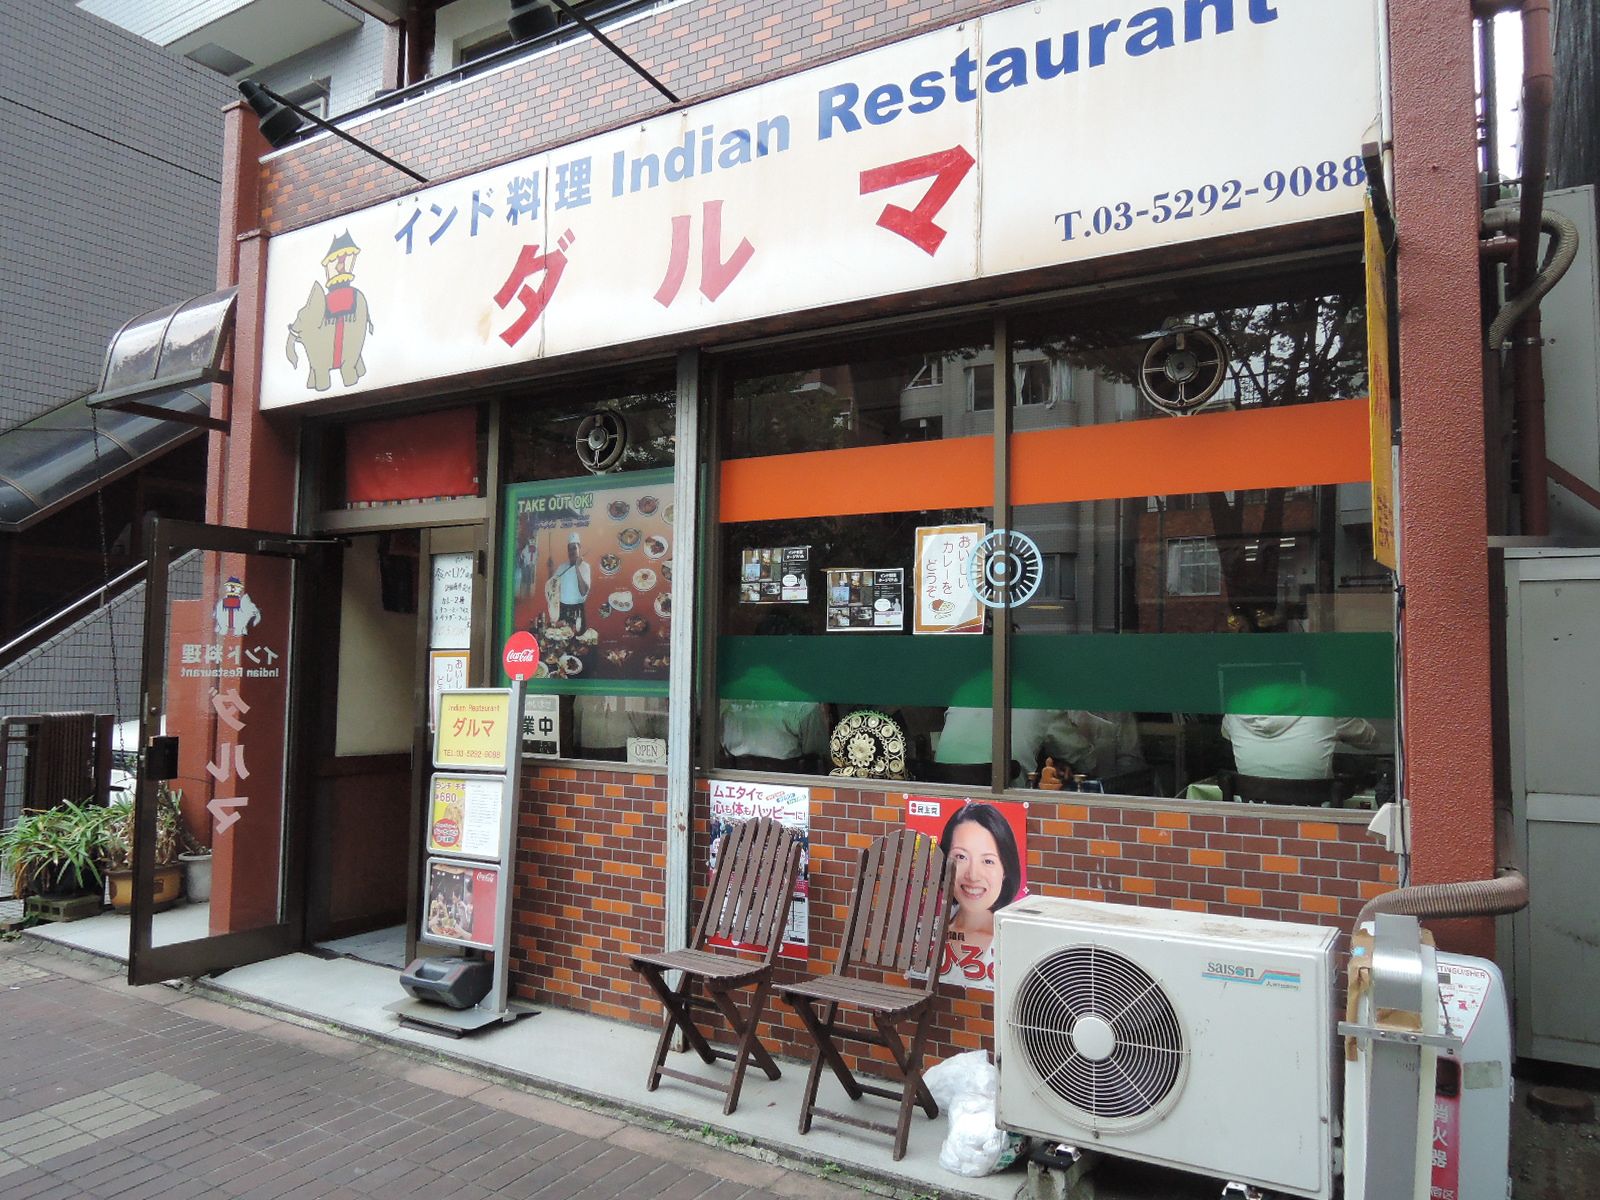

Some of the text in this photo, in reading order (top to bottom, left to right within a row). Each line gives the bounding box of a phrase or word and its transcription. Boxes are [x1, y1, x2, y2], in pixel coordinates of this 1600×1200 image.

[394, 154, 592, 254] インド料理
[612, 114, 790, 198] Indian
[1055, 154, 1368, 242] T.03-5292-9088
[493, 144, 976, 348] ダルマ
[517, 493, 594, 513] TAKE OUT OK!
[942, 541, 954, 595] カレーを
[958, 536, 973, 589] おいしい
[926, 560, 937, 598] どうぞ
[453, 717, 495, 737] ダルマ
[635, 744, 658, 756] OPEN
[713, 784, 764, 801] ムエタイで
[1207, 961, 1255, 978] saison
[1437, 965, 1486, 979] TINGUISHER
